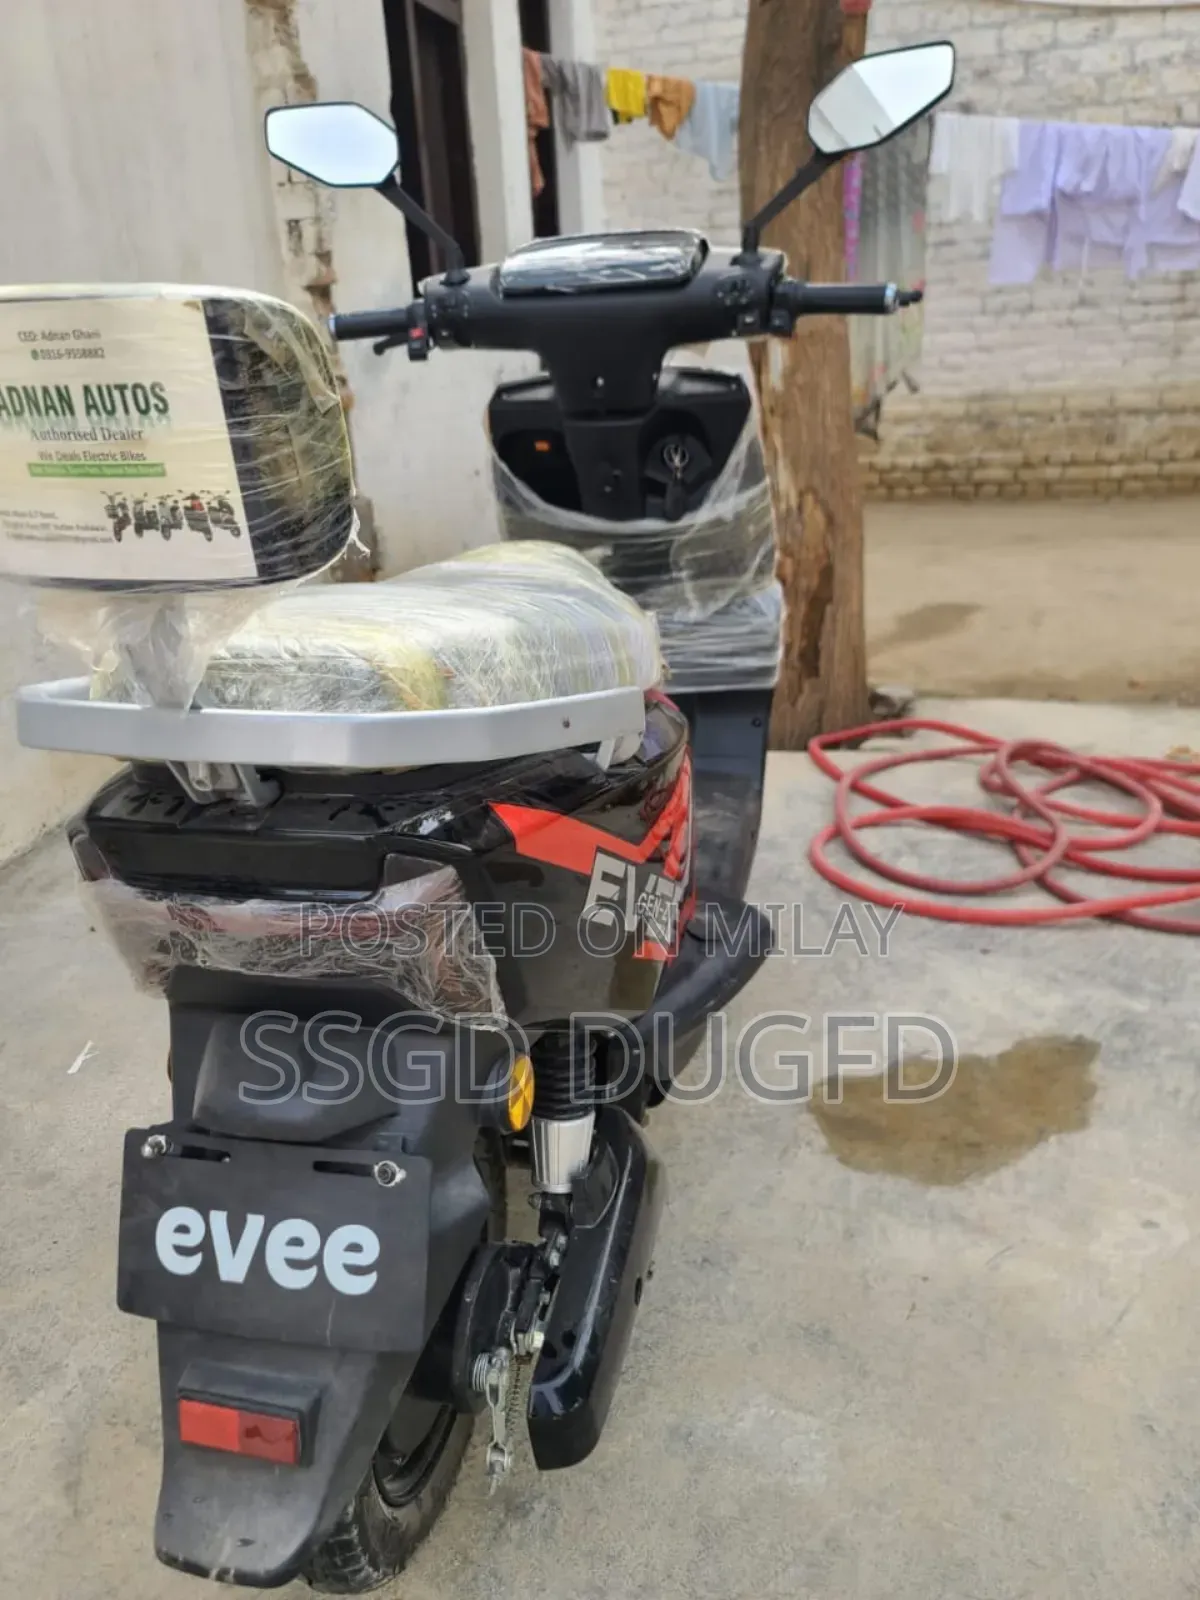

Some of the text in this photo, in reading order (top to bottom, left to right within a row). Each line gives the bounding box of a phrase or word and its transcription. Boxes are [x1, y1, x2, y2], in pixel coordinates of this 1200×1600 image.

[0, 381, 170, 418] ADNAN AUTOS
[31, 426, 144, 441] Authorised Dealer
[82, 450, 118, 461] Electric
[155, 1206, 381, 1296] evee
